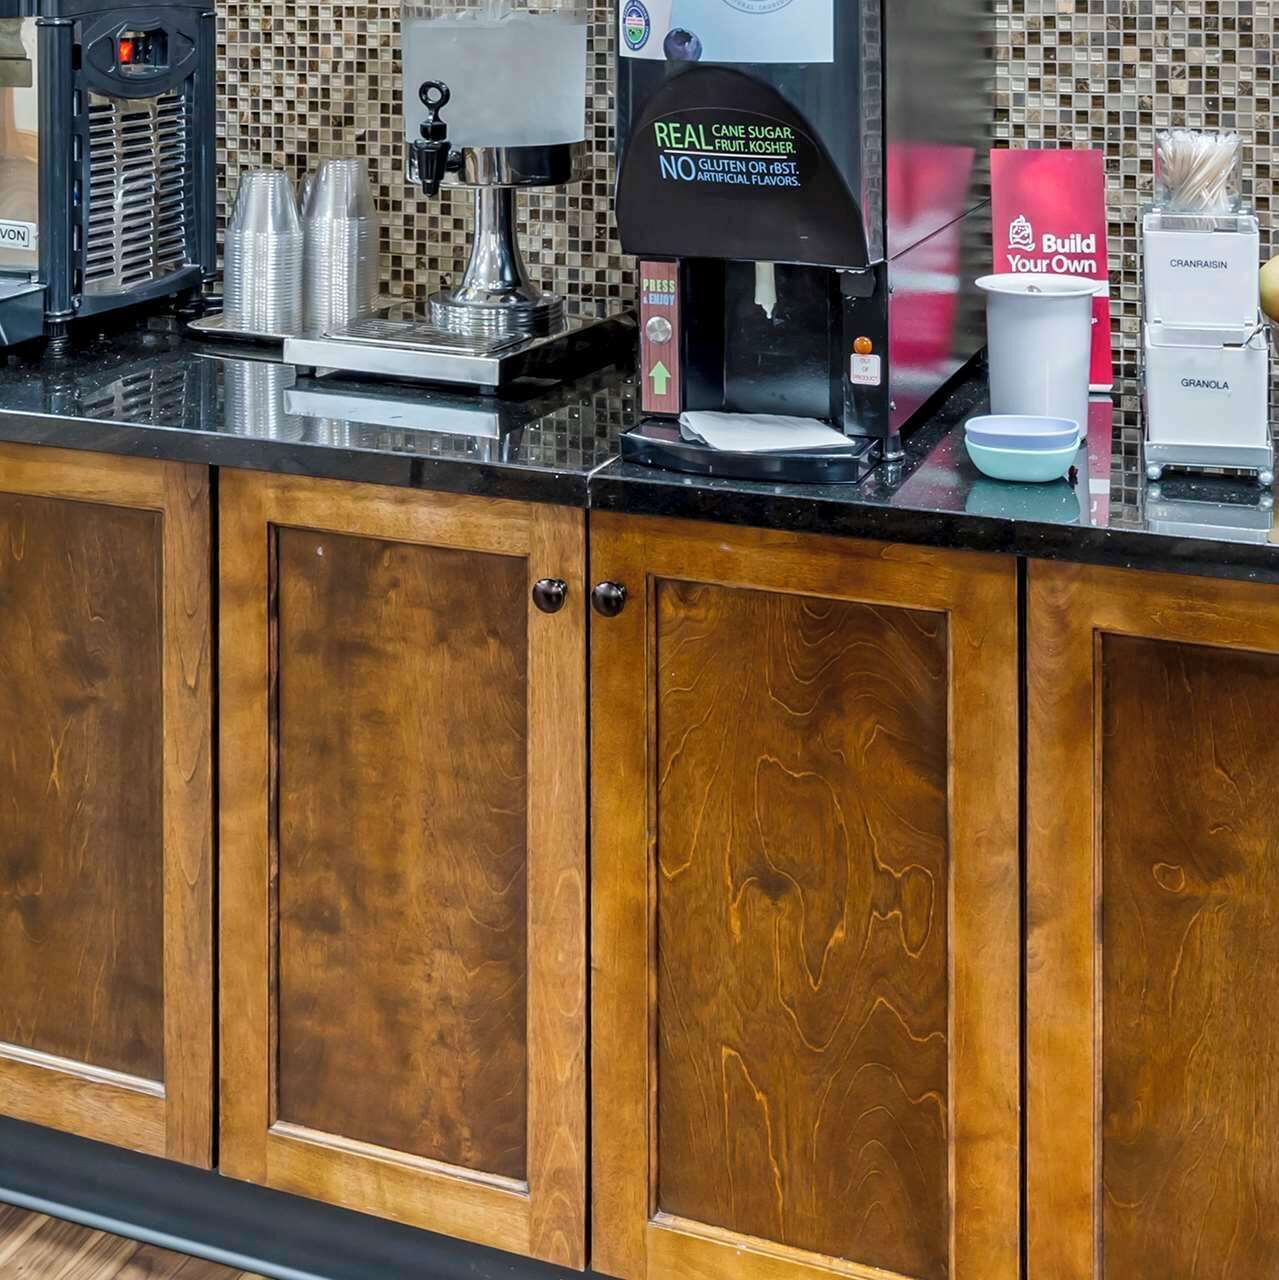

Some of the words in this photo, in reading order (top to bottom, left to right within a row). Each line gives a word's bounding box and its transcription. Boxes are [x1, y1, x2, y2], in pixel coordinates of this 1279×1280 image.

[654, 122, 714, 150] REAL
[712, 124, 746, 138] CANE
[749, 126, 795, 139] SUGAR.
[715, 139, 748, 152] FRUIT.
[749, 141, 797, 154] KOSHER.
[659, 154, 696, 181] NO
[698, 158, 746, 173] GLUTEN
[748, 161, 767, 173] OR
[769, 162, 800, 175] rBST.
[696, 172, 751, 185] ARTIFICIAL
[752, 175, 801, 187] FLAVORS.
[1042, 233, 1096, 253] Build
[1006, 254, 1049, 273] Your
[1051, 255, 1097, 273] Own
[1170, 259, 1228, 269] CRANRAISIN
[643, 278, 675, 293] PRESS
[648, 293, 675, 306] ENJOY
[1180, 378, 1229, 390] GRANOLA
